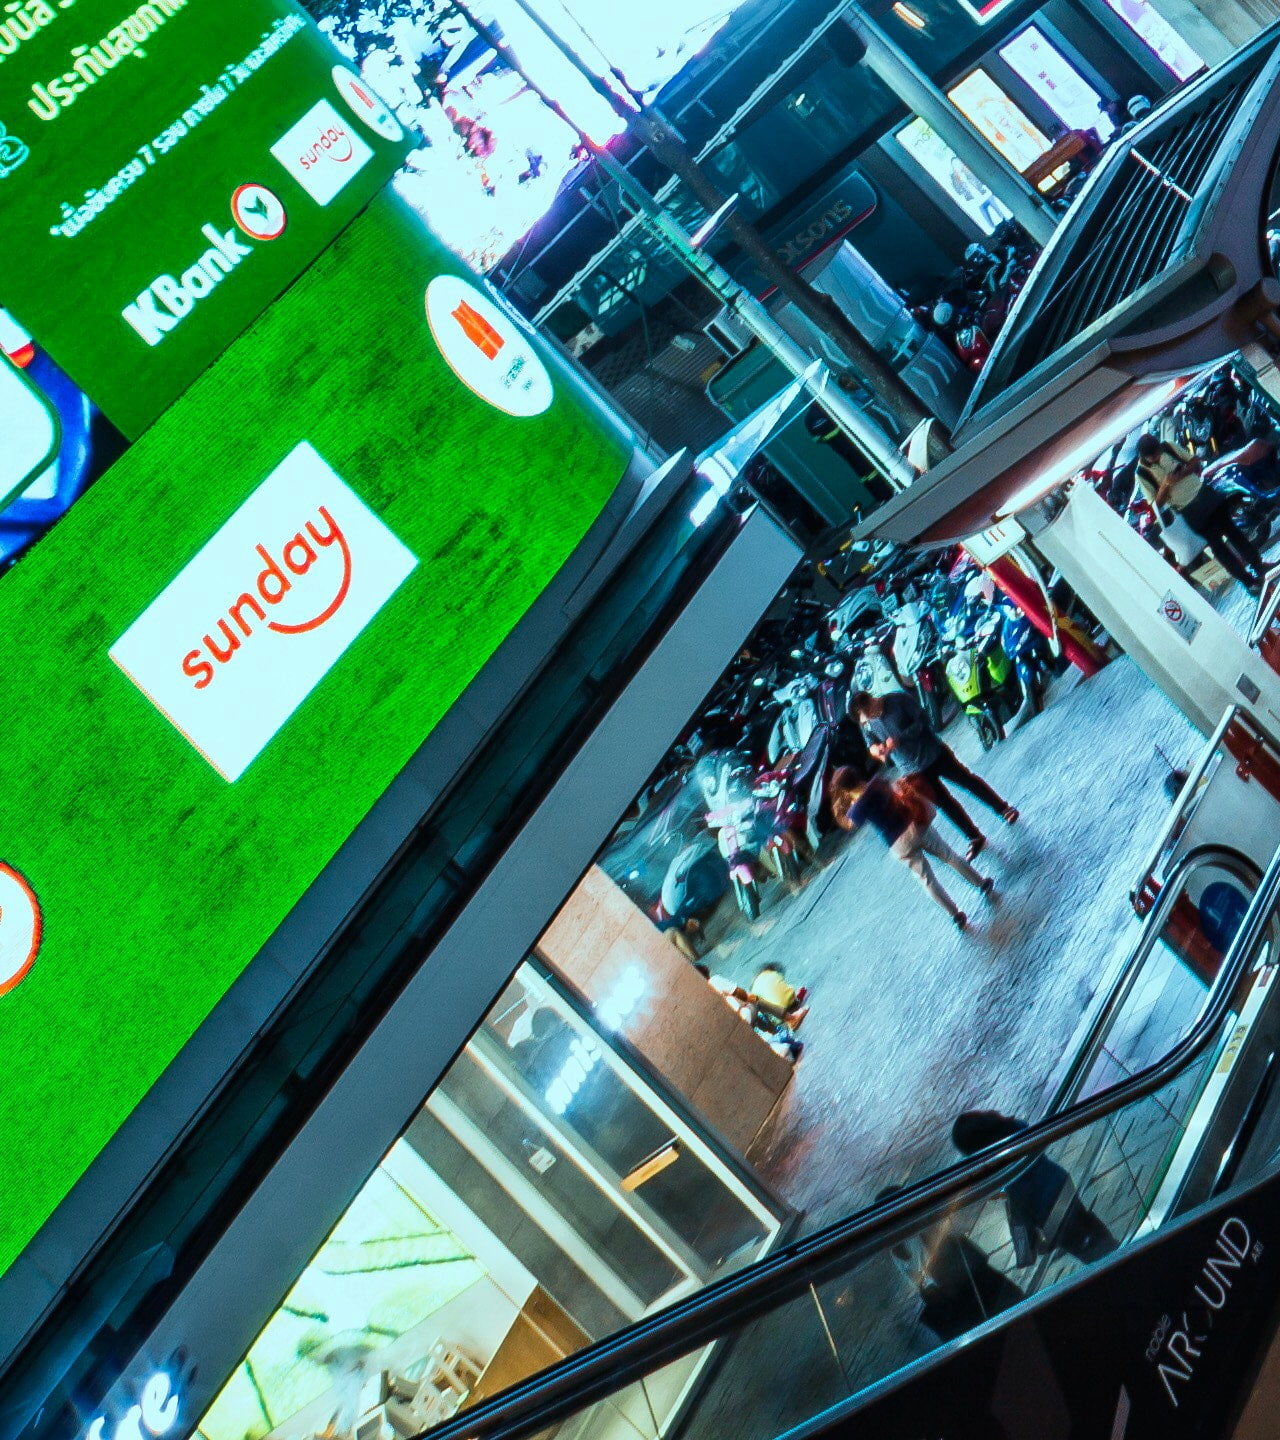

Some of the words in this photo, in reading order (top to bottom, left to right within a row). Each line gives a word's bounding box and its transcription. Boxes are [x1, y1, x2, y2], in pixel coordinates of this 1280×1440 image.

[298, 119, 354, 173] sunday
[121, 223, 253, 347] KBank
[181, 506, 352, 690] sunday
